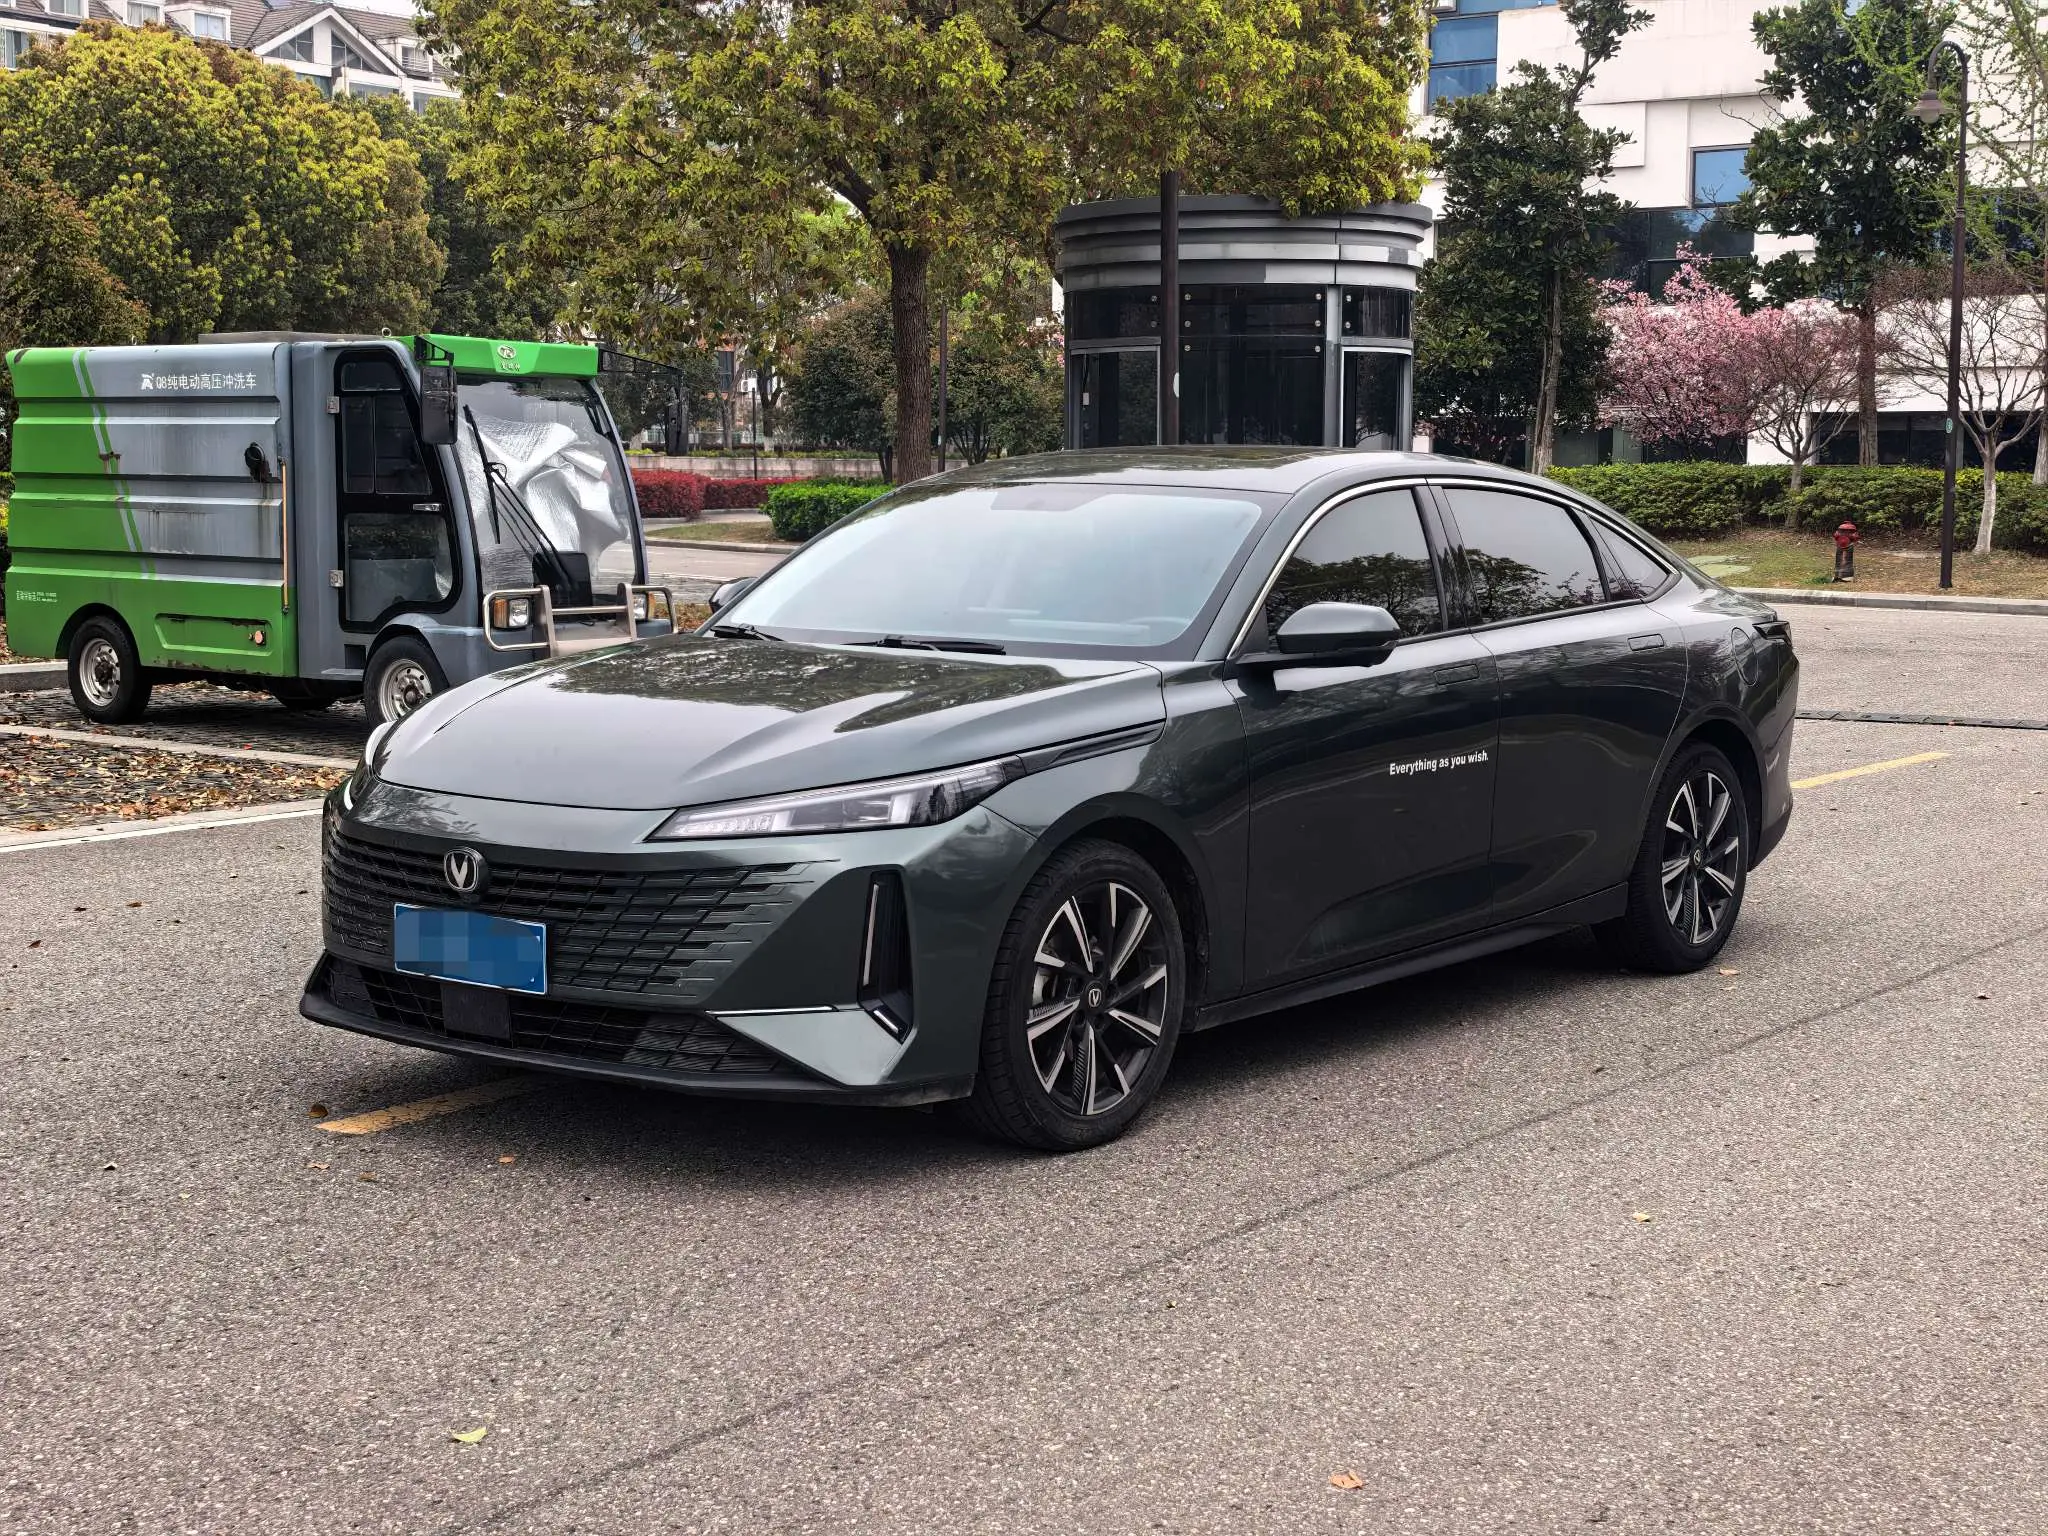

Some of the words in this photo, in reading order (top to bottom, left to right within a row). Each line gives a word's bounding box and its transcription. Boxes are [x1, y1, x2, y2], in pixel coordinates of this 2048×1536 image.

[1389, 759, 1437, 775] Everything
[1439, 758, 1449, 768] as
[1450, 755, 1466, 769] you
[1467, 750, 1489, 764] wish.
